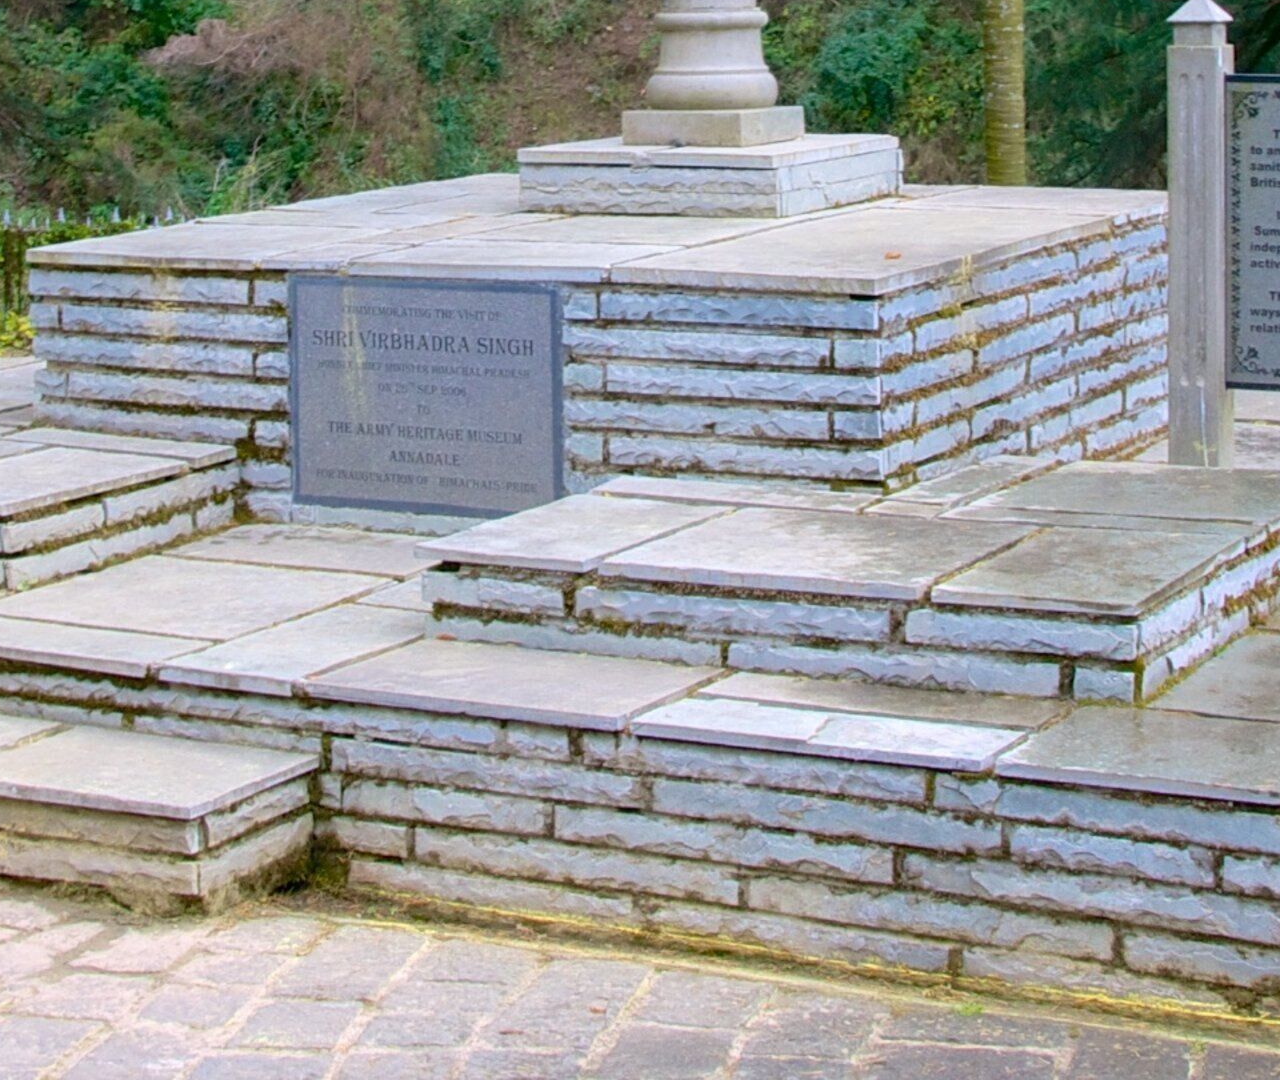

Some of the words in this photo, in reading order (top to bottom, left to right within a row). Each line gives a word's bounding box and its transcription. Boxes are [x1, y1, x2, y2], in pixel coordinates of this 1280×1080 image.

[1250, 145, 1262, 157] to
[1266, 148, 1280, 157] an
[1250, 308, 1280, 321] ways
[312, 329, 353, 348] SHRI
[358, 330, 470, 354] VIRBHADRA
[476, 337, 534, 357] SINGH
[328, 420, 352, 434] THE
[356, 422, 394, 437] ARMY
[397, 425, 464, 442] HERITAGE
[467, 429, 522, 445] MUSEUM
[389, 450, 461, 467] ANNADALE
